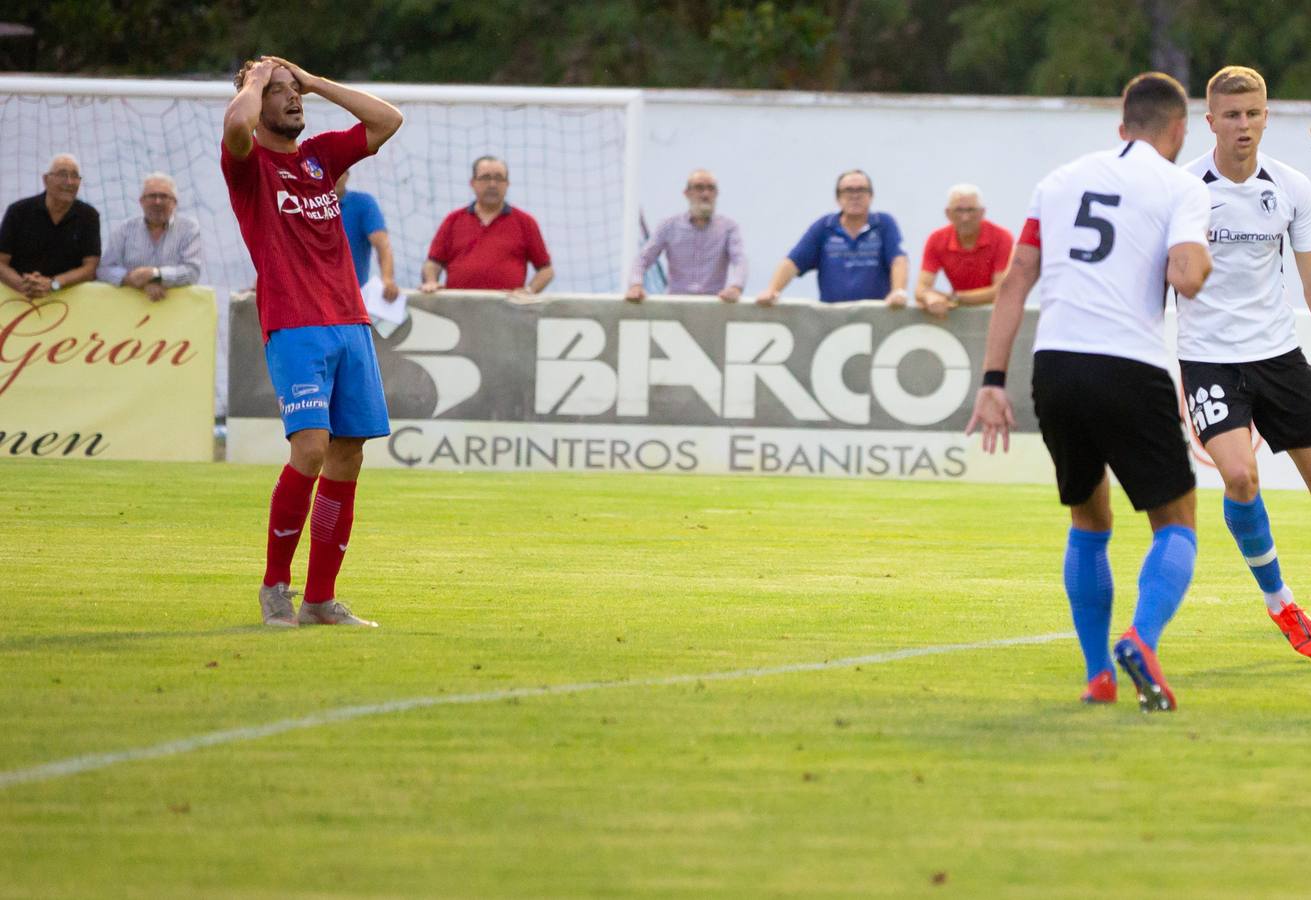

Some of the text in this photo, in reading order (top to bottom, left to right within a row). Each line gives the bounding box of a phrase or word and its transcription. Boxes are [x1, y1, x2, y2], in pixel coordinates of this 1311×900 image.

[1070, 191, 1121, 264] 5
[0, 299, 198, 397] Gerón
[535, 317, 972, 426] BARCO
[388, 426, 967, 478] CARPINTEROS EBANISTAS
